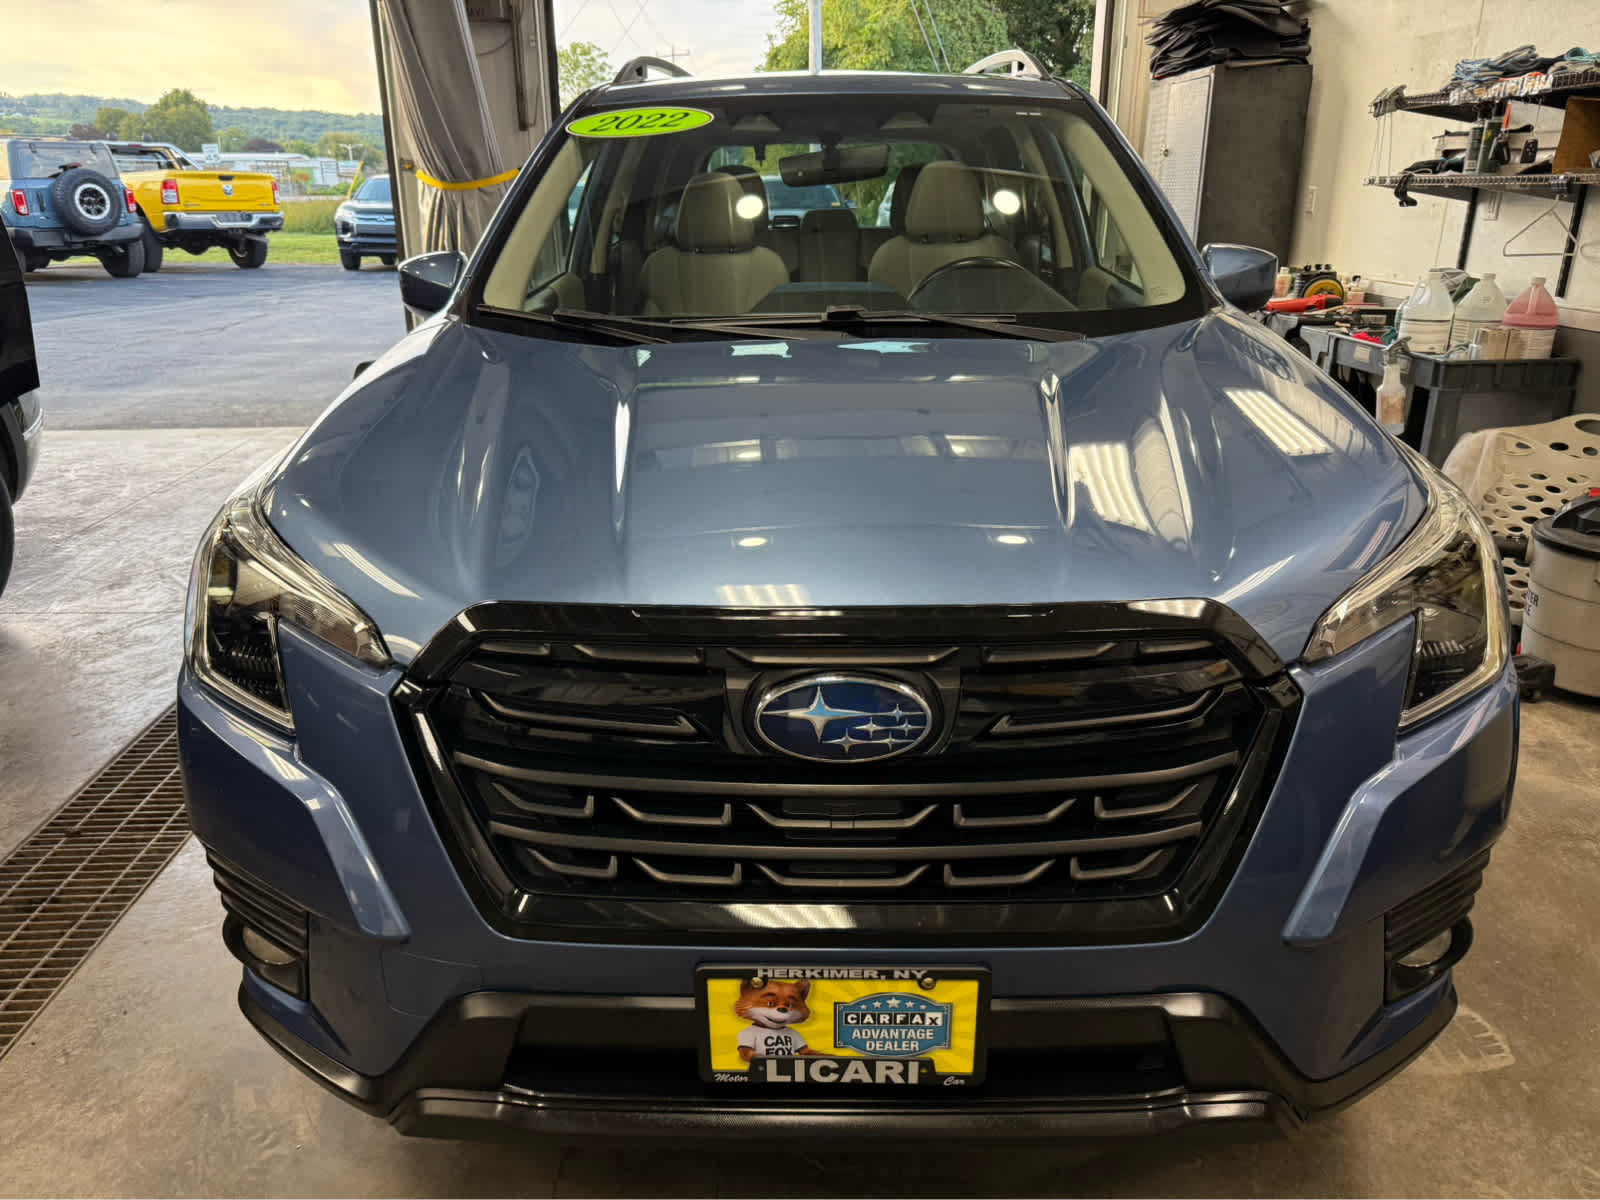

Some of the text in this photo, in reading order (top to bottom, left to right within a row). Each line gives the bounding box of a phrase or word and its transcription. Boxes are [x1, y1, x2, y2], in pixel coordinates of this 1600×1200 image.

[588, 112, 690, 132] 2022
[757, 968, 927, 981] HERKIMER, NY
[847, 1014, 940, 1026] CARFAX
[852, 1028, 935, 1040] ADVANTAGE
[764, 1035, 793, 1047] CAR
[866, 1041, 920, 1051] DEALER
[765, 1048, 795, 1056] FOX
[714, 1073, 749, 1083] Motor
[766, 1060, 919, 1084] LICARI
[943, 1076, 966, 1086] Car
